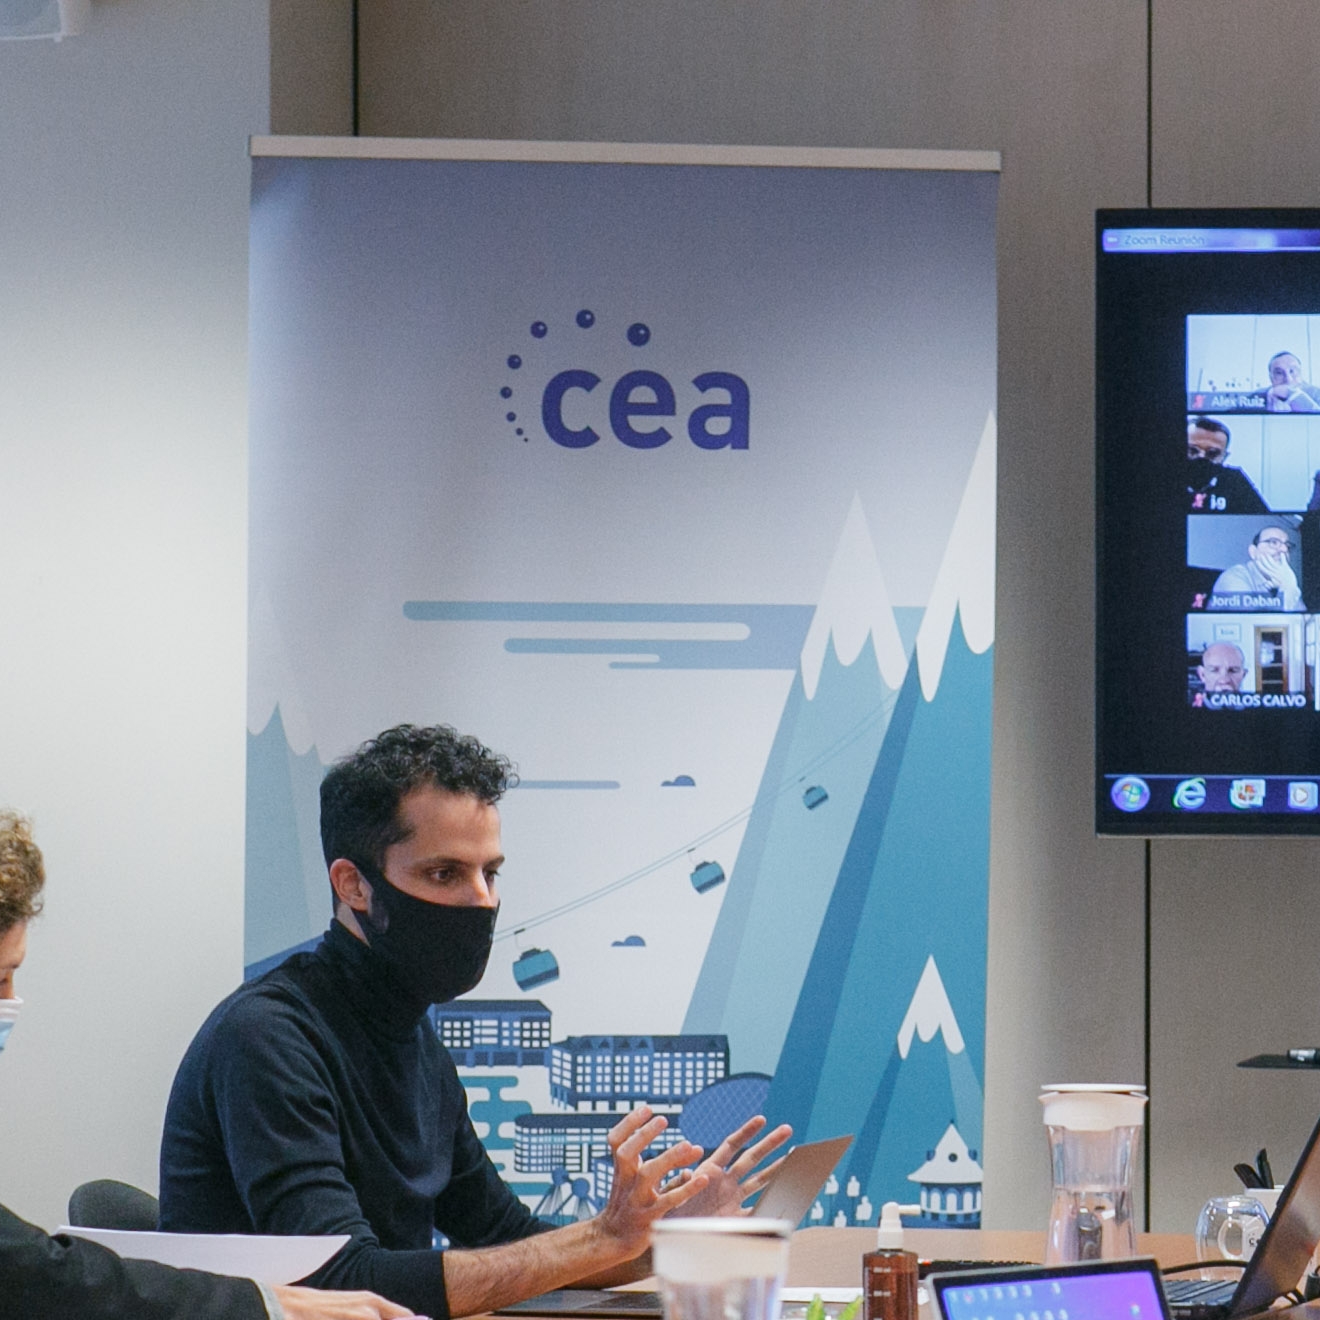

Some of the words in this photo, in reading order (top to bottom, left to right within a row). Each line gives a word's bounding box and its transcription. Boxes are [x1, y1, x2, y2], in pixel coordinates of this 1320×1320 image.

[1125, 235, 1156, 246] Zoom
[1211, 395, 1236, 408] Alex
[1239, 395, 1266, 408] Ruiz
[541, 369, 751, 451] cea
[1211, 594, 1241, 608] Jordi
[1242, 594, 1281, 608] Daban
[1211, 693, 1261, 708] CARLOS
[1262, 693, 1307, 708] CALVO
